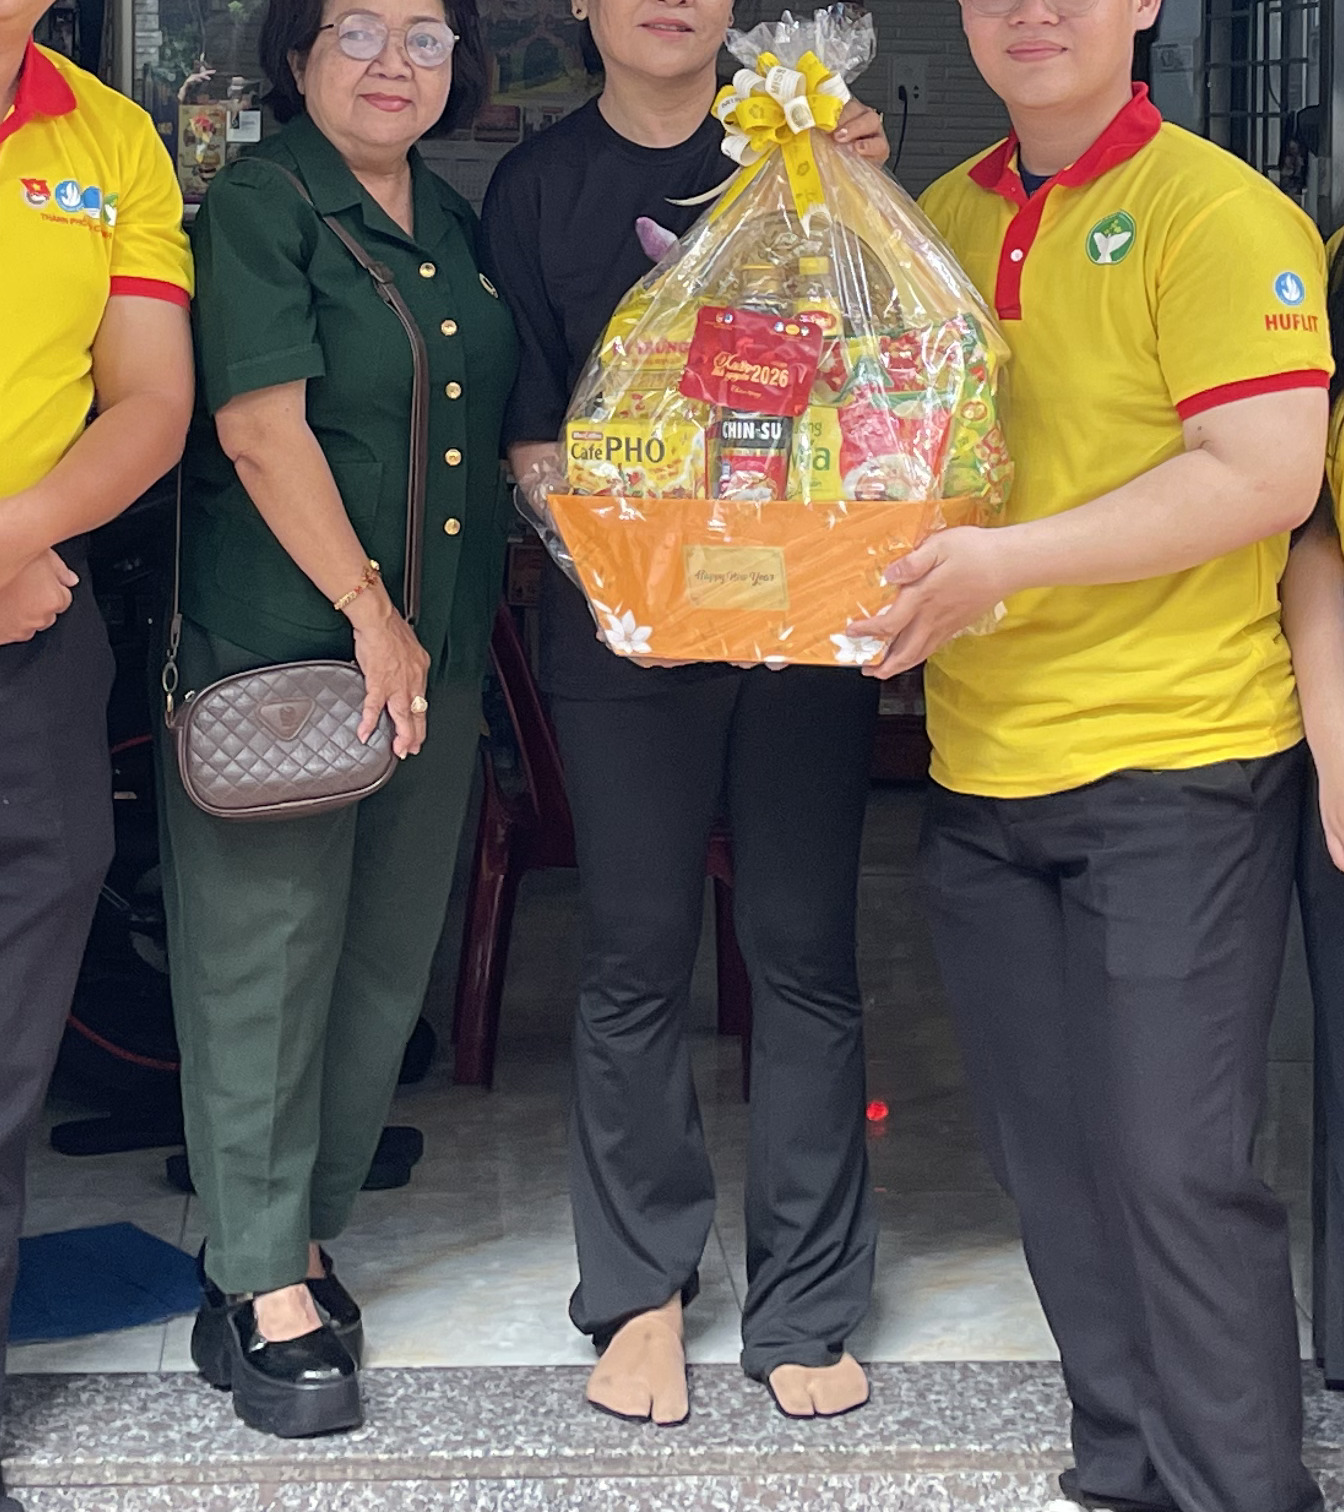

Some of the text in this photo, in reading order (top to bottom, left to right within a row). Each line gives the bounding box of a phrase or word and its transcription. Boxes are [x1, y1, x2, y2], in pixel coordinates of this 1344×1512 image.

[1265, 313, 1319, 333] HUFLIT
[750, 365, 789, 388] 2026
[722, 421, 783, 440] CHIN-SU
[571, 440, 604, 461] Café
[695, 570, 726, 584] Happy
[749, 572, 775, 586] Year
